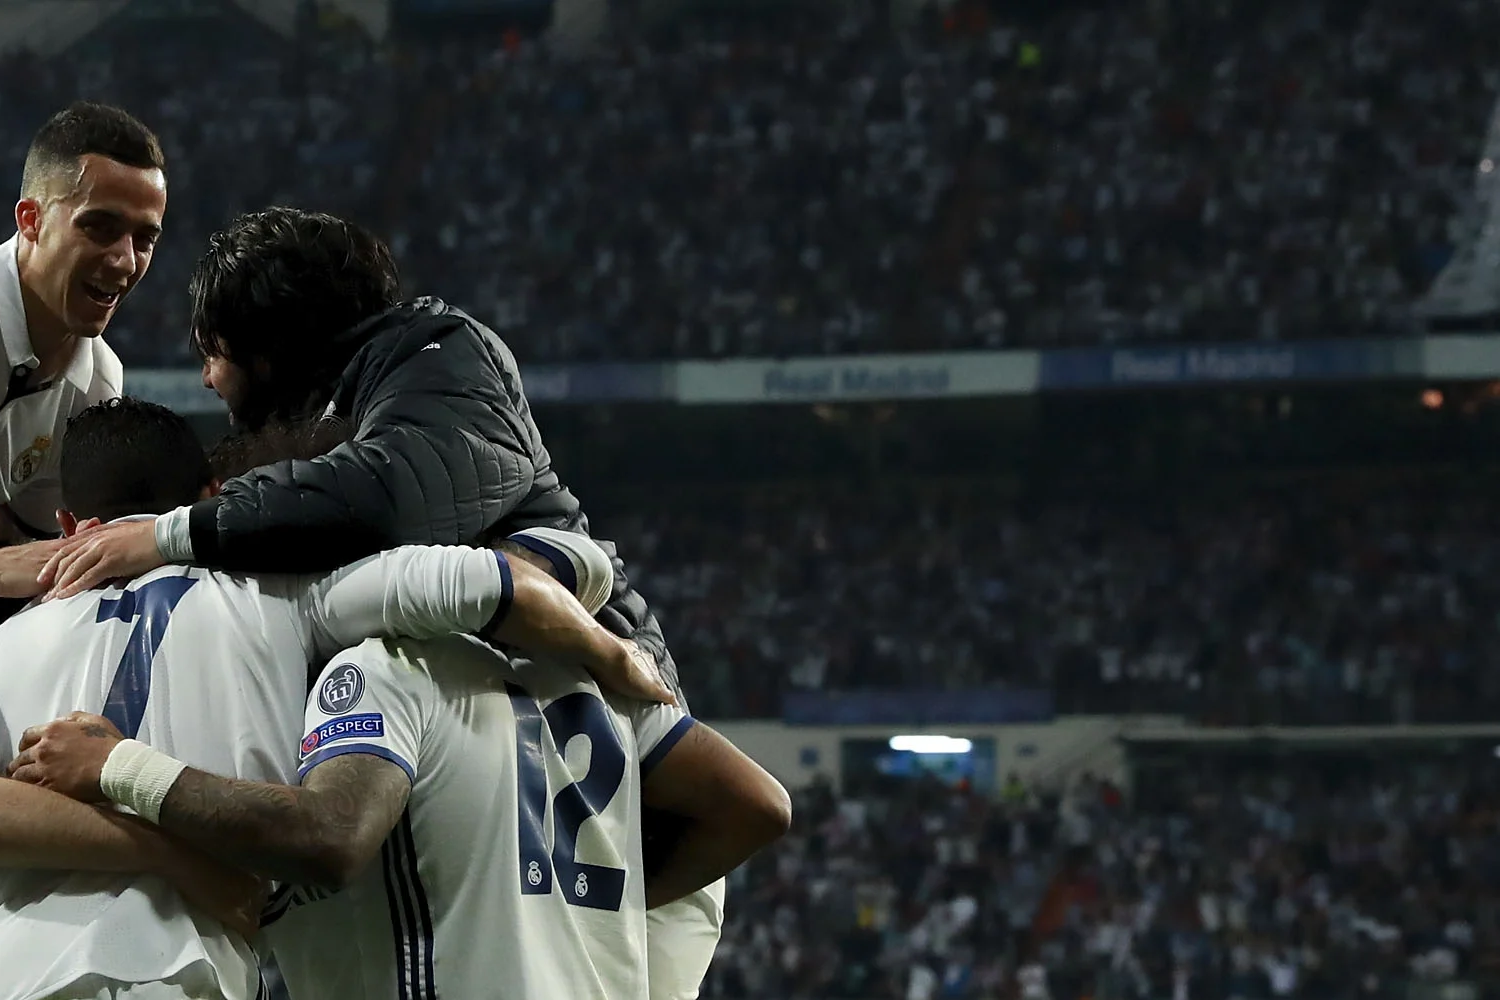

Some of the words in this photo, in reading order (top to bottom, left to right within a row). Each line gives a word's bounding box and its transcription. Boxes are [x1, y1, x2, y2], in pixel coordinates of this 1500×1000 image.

[95, 573, 198, 740] 7
[331, 686, 350, 703] 11
[320, 720, 383, 741] RESPECT
[504, 680, 627, 912] 12
